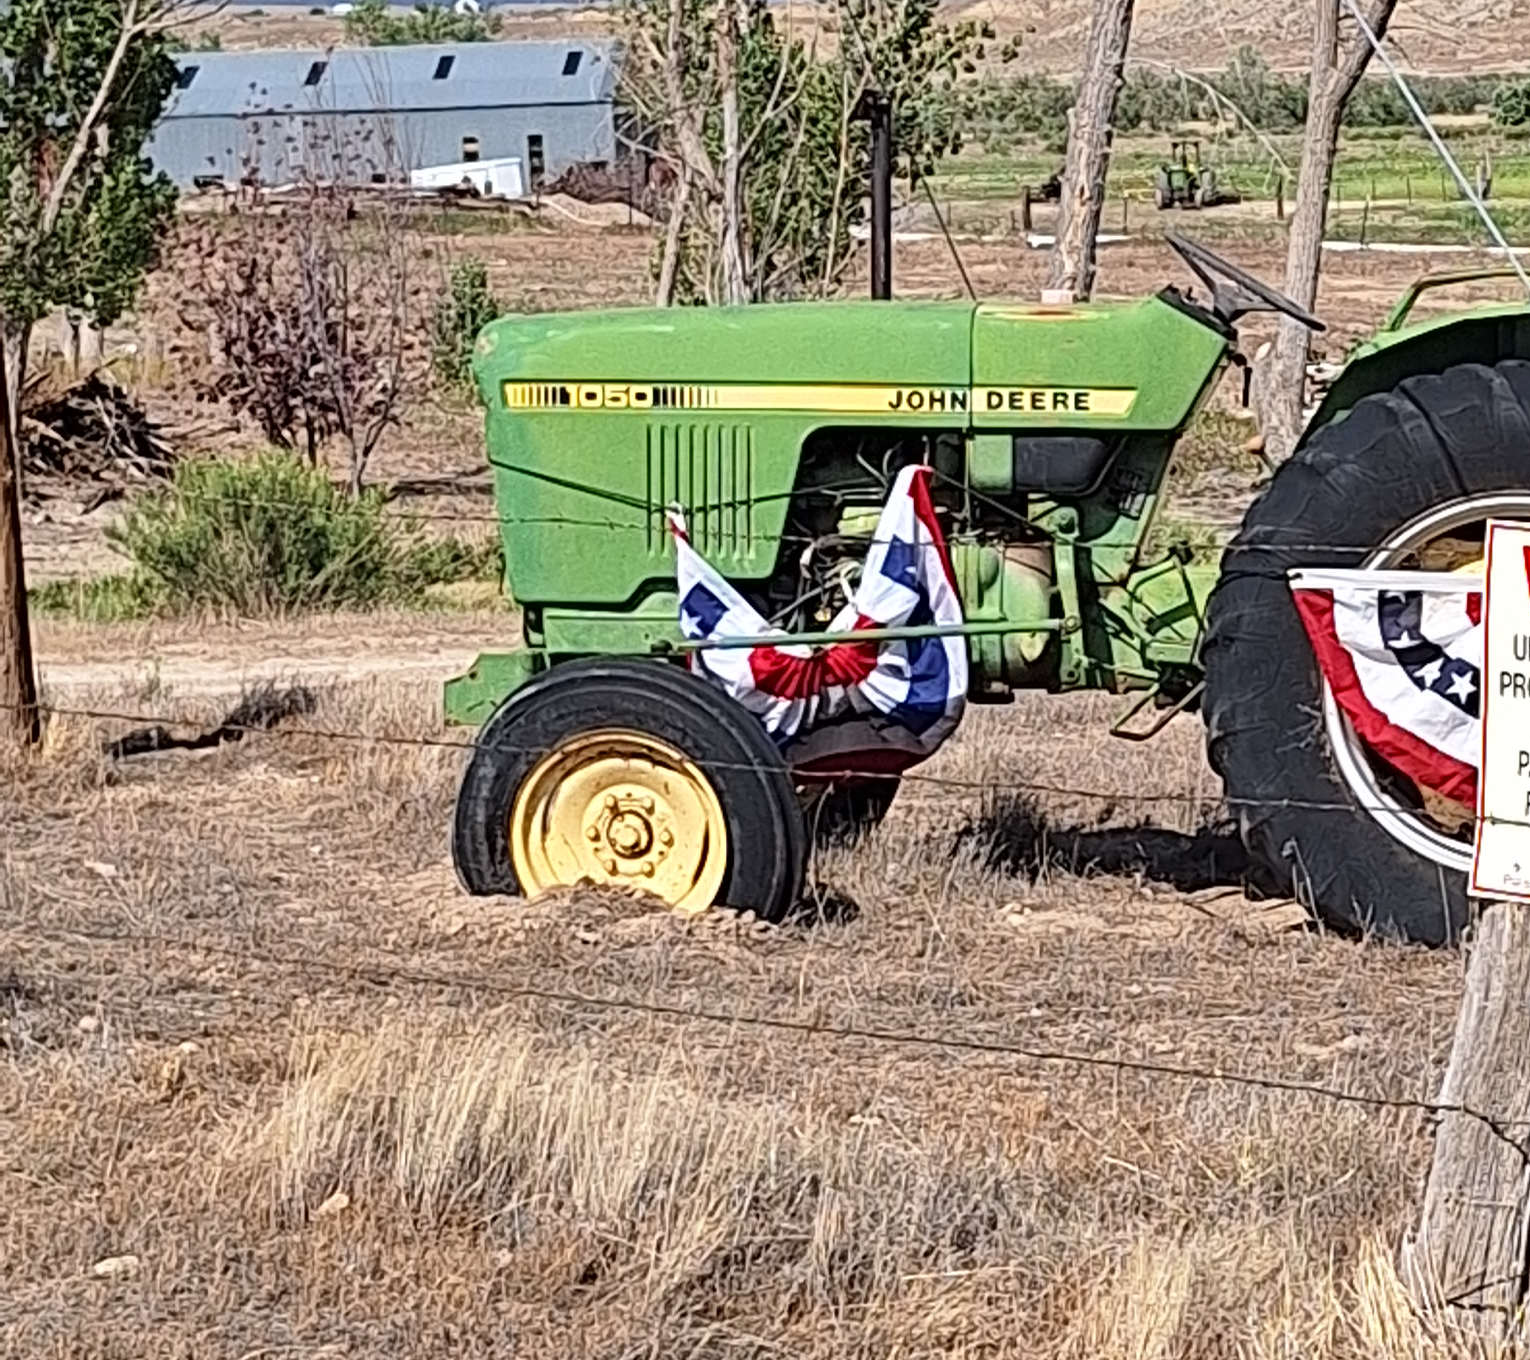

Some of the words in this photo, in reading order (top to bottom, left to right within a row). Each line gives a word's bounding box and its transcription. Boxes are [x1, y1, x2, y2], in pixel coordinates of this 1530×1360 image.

[566, 384, 653, 409] 1050
[888, 390, 967, 410] JOHN
[987, 391, 1090, 411] DEERE
